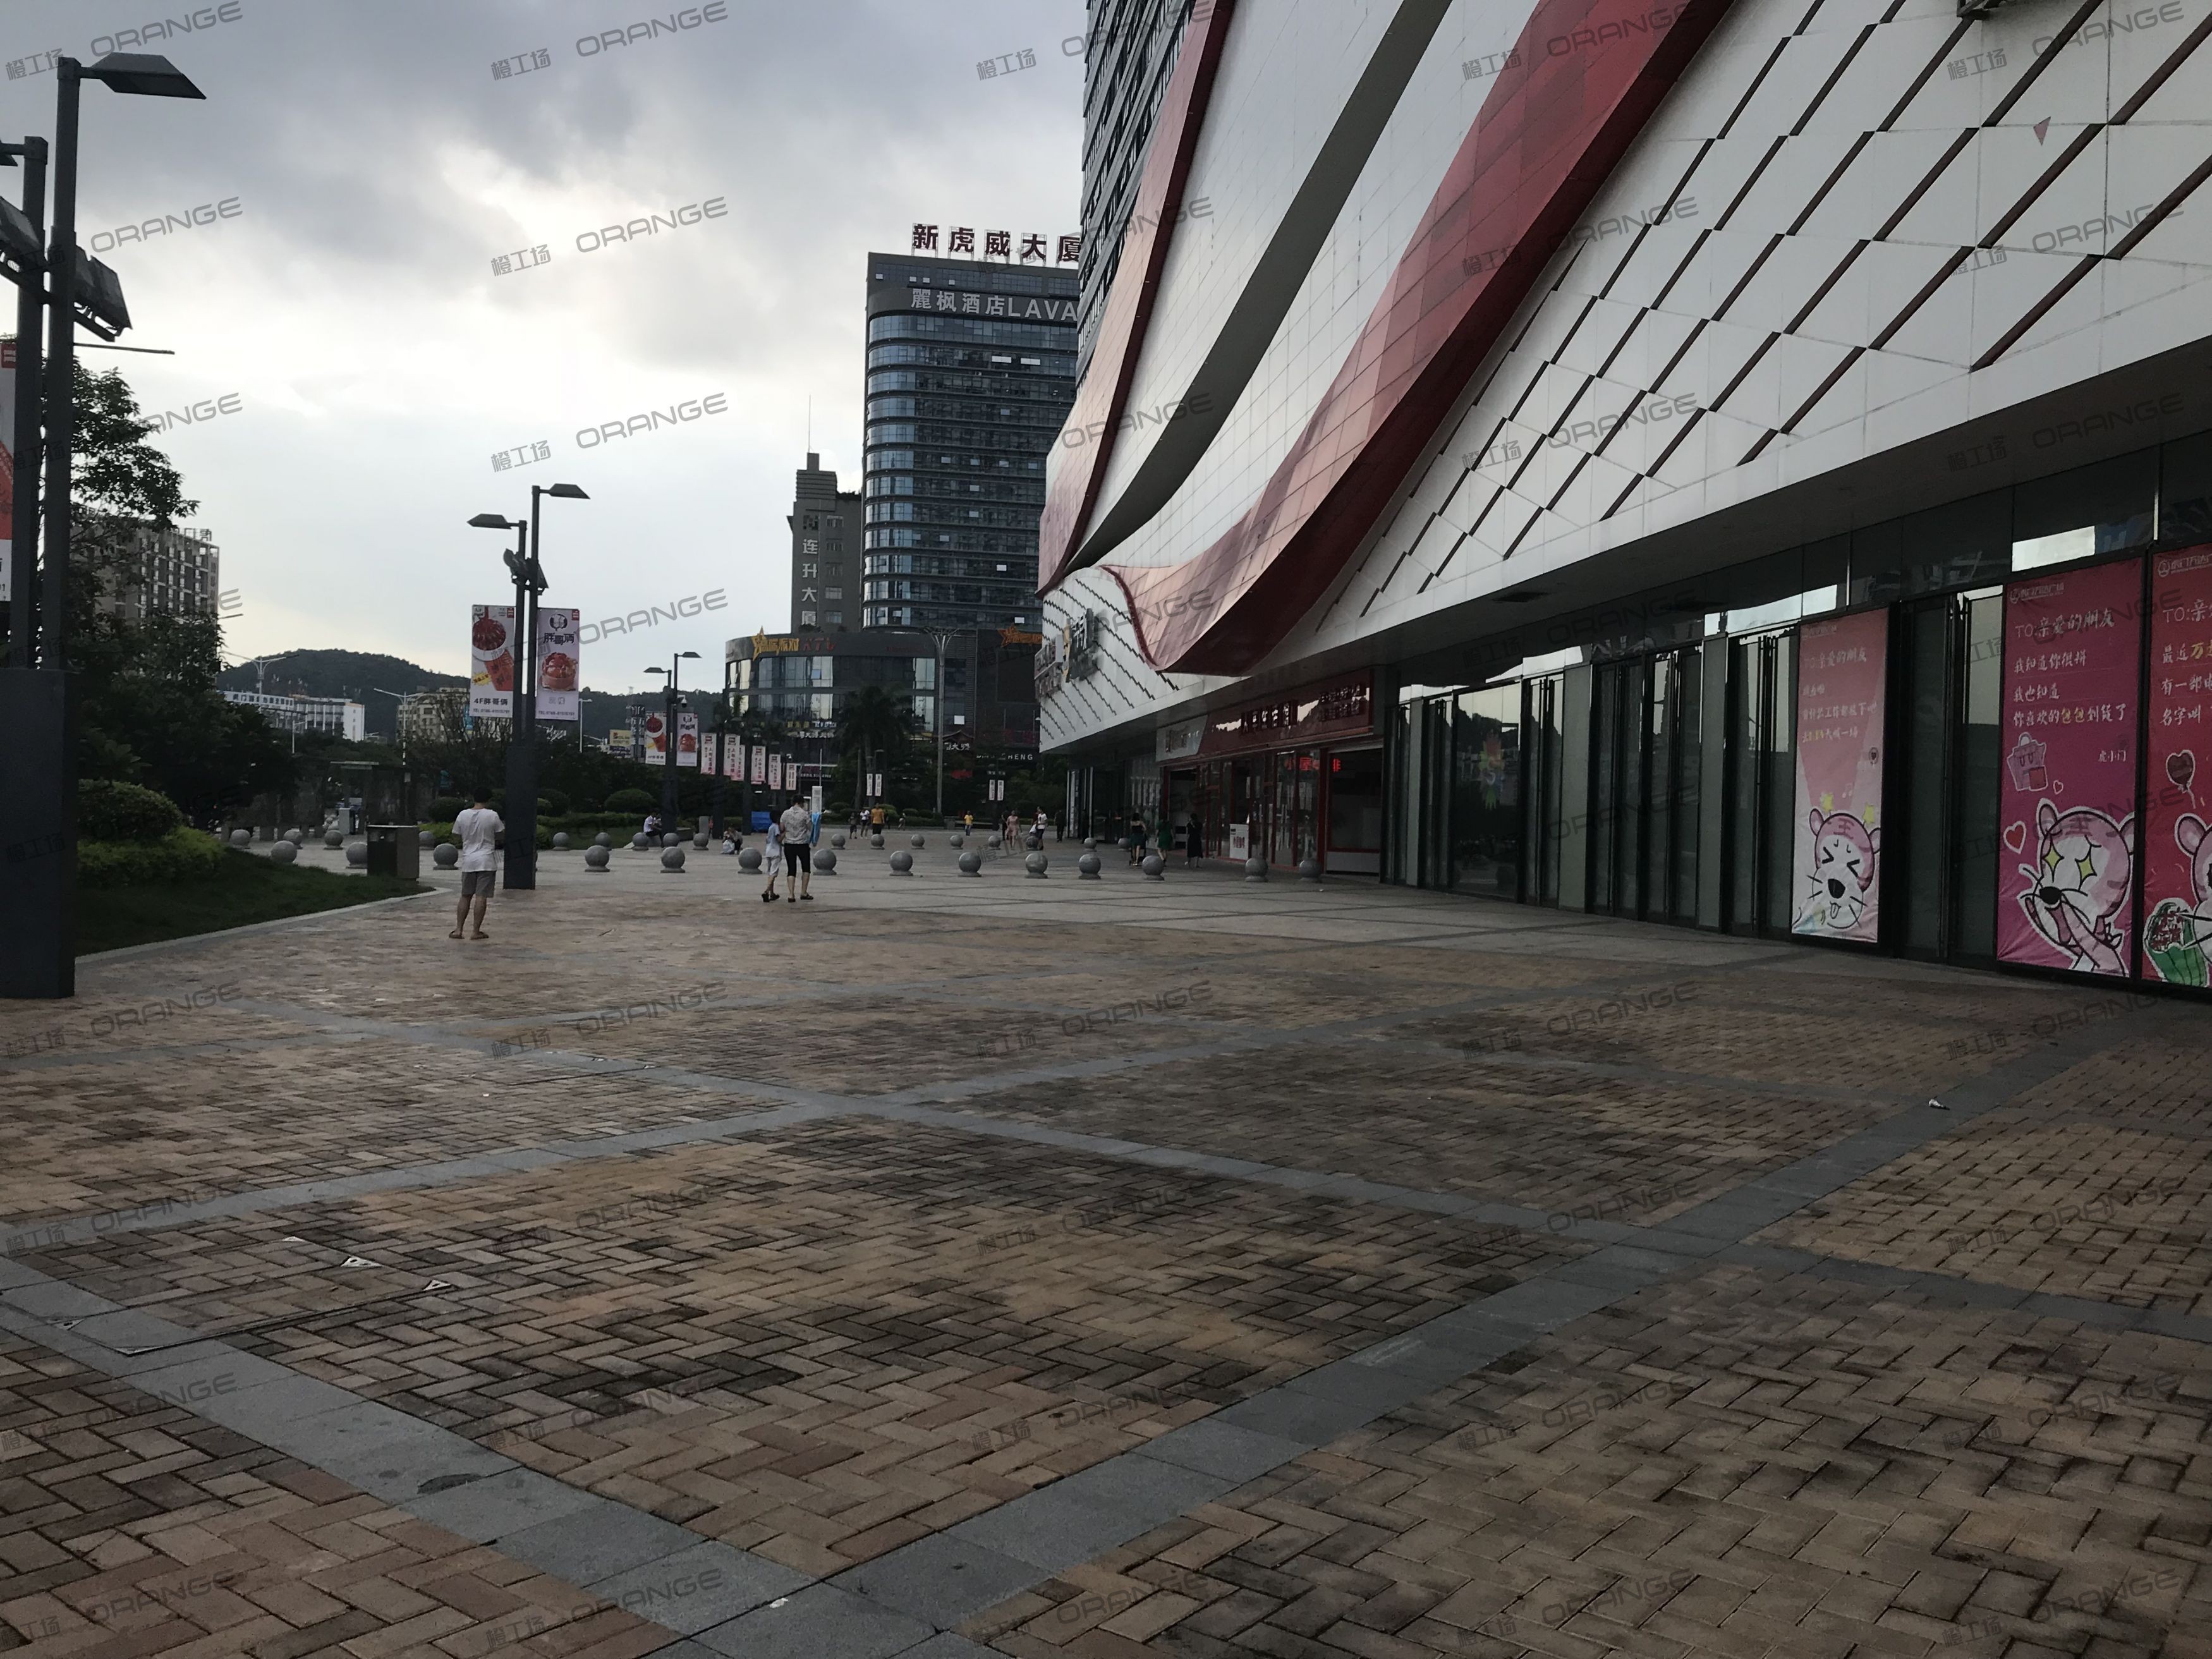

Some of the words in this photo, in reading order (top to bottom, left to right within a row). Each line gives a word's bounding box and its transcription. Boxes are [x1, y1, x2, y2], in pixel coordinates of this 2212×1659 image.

[913, 224, 1079, 262] 新虎威大厦
[801, 538, 818, 626] 连升大厦
[2163, 599, 2212, 623] TO:亲
[2160, 705, 2201, 726] 名字叫
